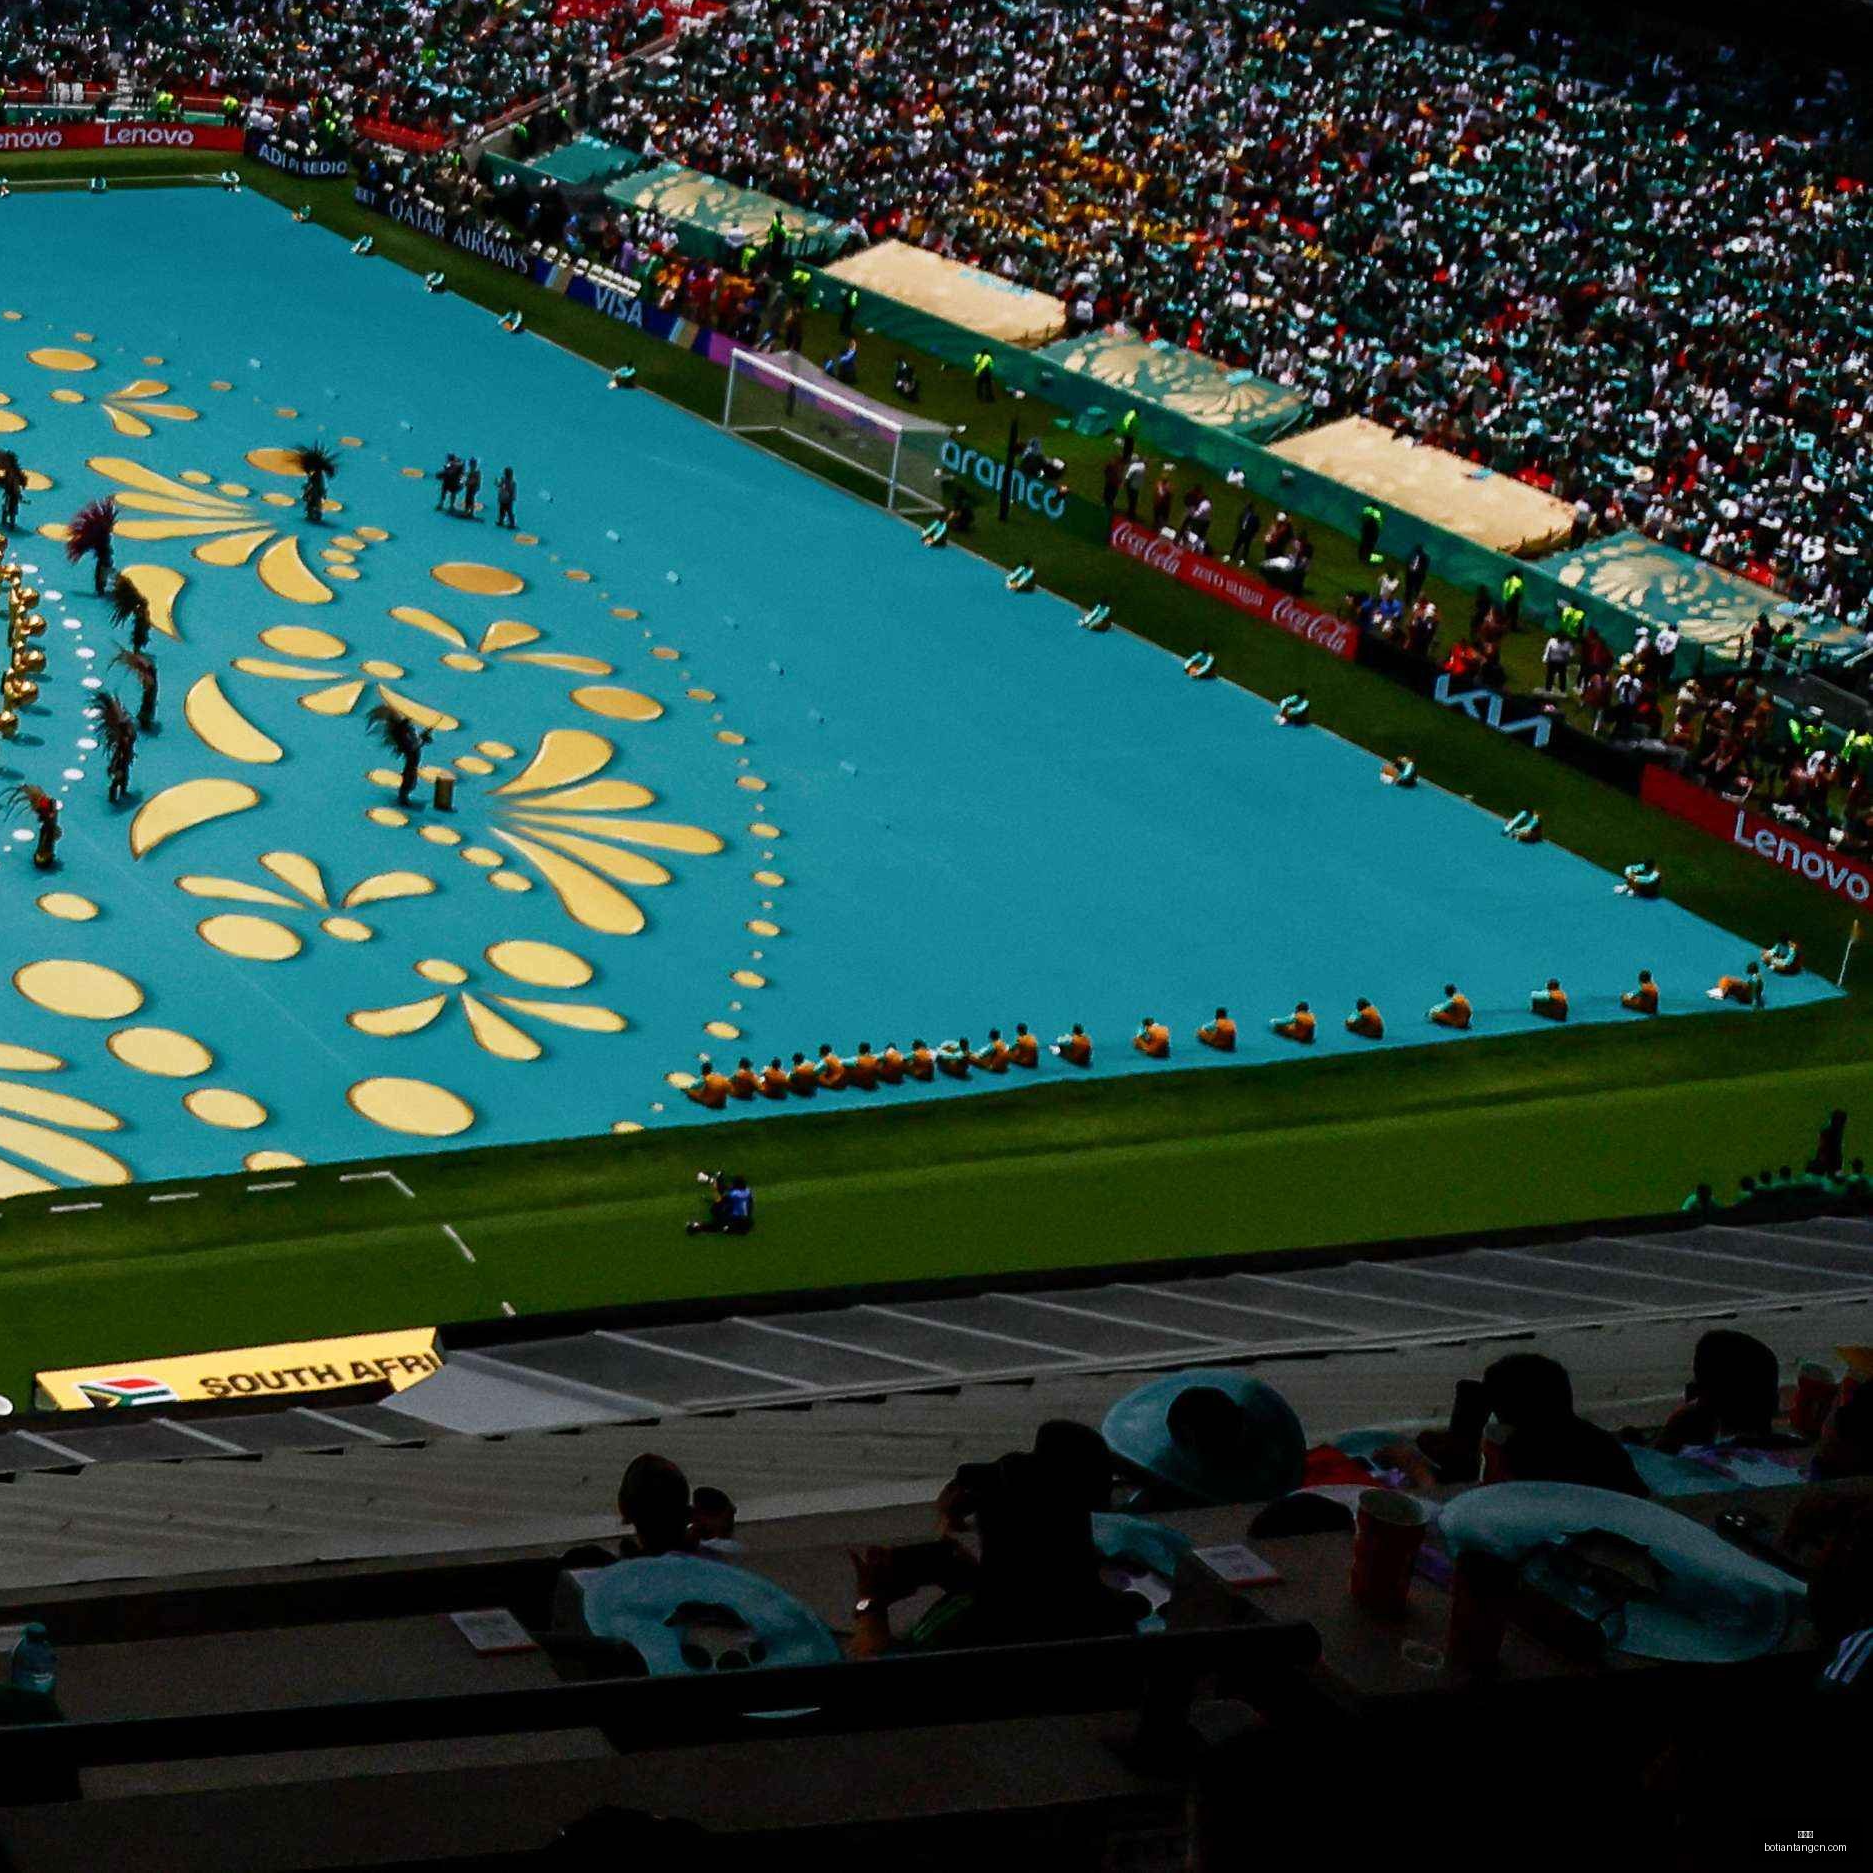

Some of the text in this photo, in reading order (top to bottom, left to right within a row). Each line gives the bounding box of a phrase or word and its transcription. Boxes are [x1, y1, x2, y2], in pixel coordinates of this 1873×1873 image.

[104, 125, 194, 146] Lenovo
[595, 286, 643, 328] VISA
[1434, 673, 1552, 748] KIA
[1734, 809, 1871, 902] Lenovo
[199, 1363, 345, 1397] SOUTH
